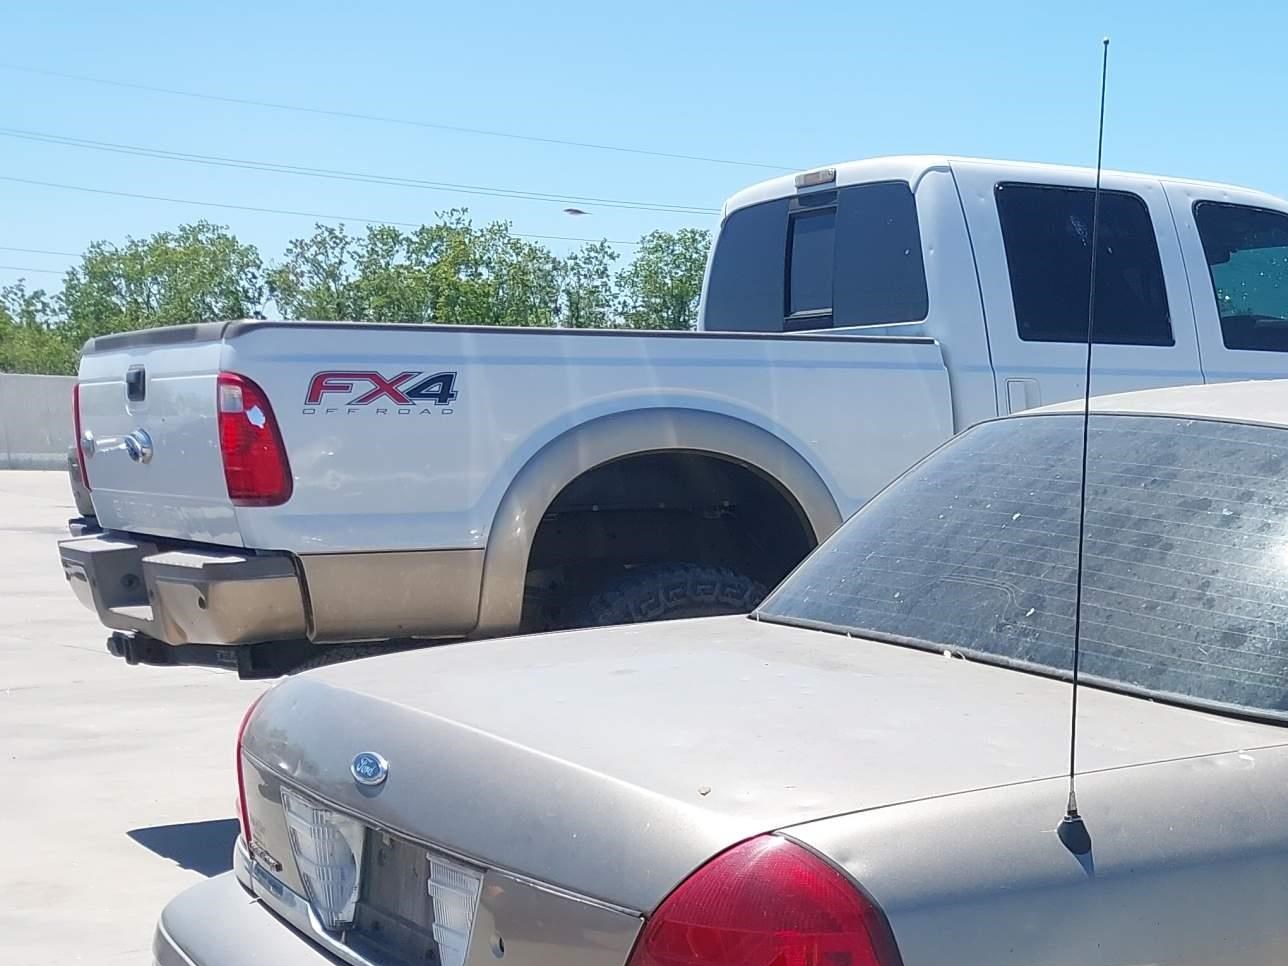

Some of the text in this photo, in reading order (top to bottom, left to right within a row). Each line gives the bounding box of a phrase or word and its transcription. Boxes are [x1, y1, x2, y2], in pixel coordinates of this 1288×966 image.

[303, 370, 459, 406] FX4
[302, 407, 455, 415] OFF ROAD
